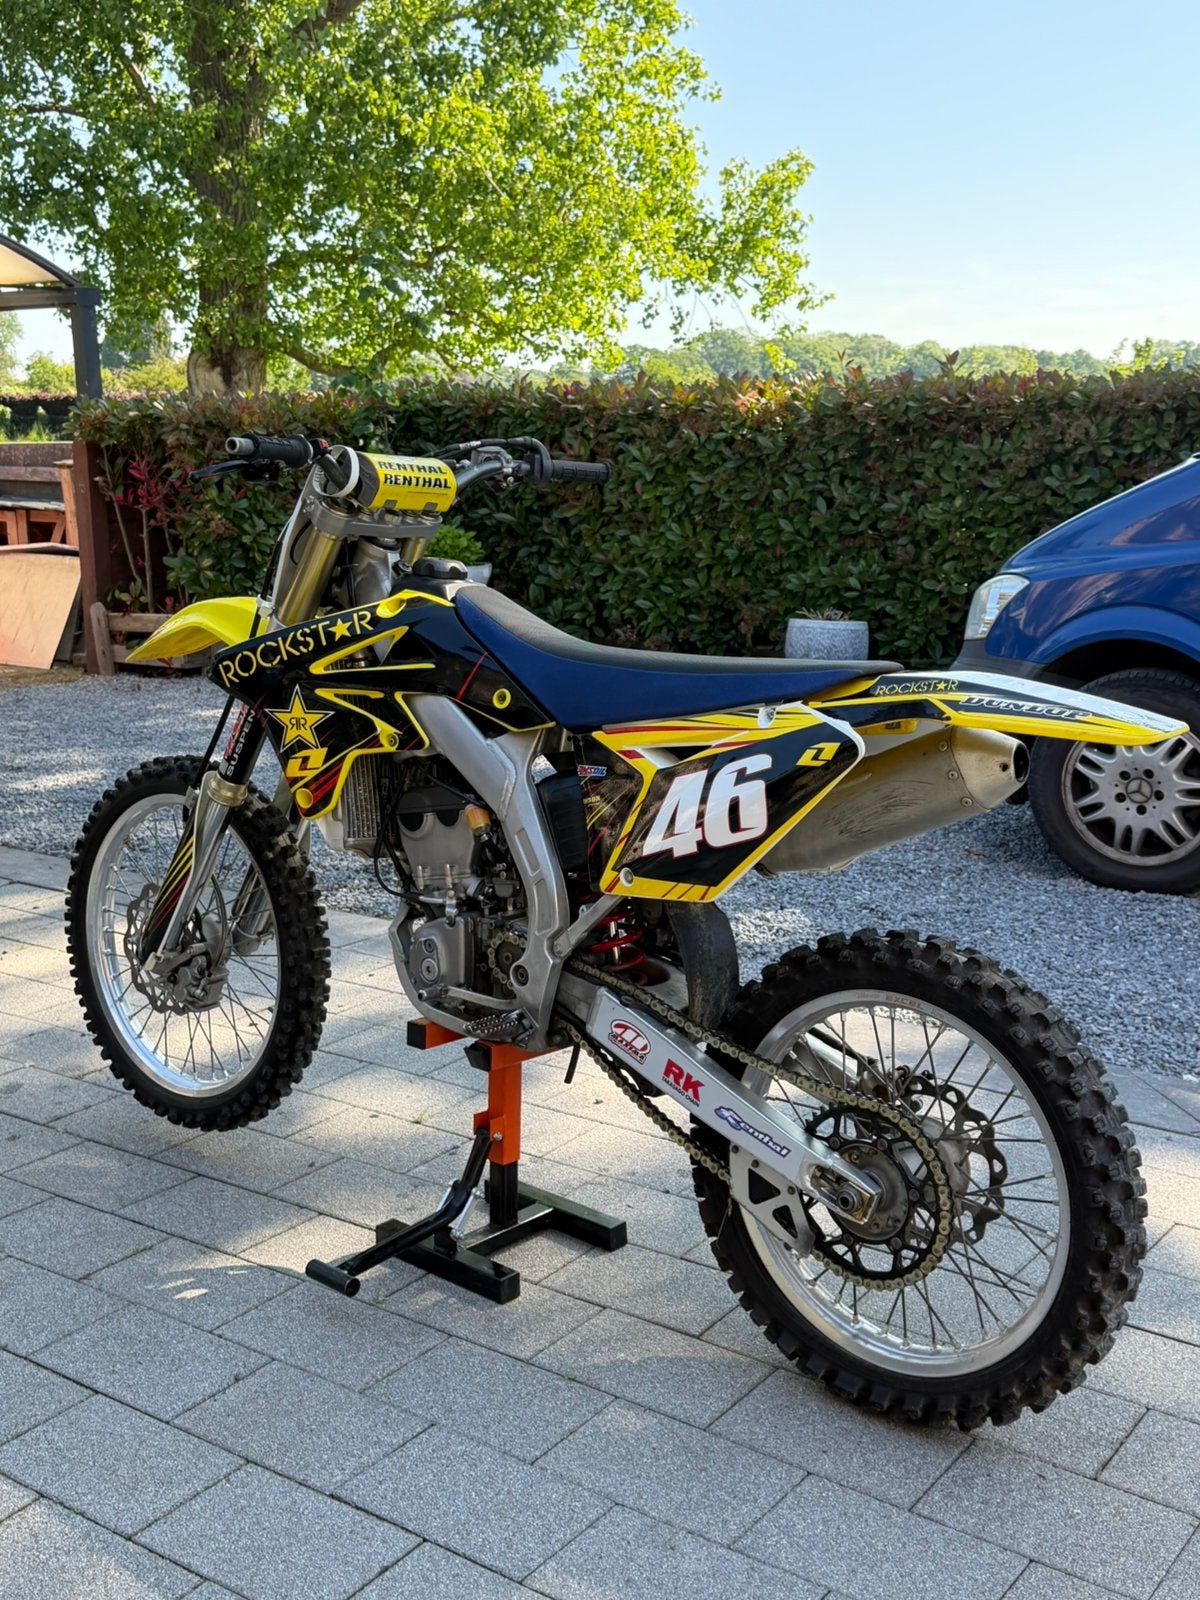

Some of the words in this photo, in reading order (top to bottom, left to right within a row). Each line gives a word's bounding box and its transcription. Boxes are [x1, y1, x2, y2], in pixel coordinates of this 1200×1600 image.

[378, 461, 447, 474] RENTHAL
[384, 473, 451, 489] RENTHAL
[959, 696, 1092, 720] DUNLOP
[641, 753, 773, 860] 46
[663, 1058, 705, 1102] RK
[714, 1105, 791, 1157] Renthal
